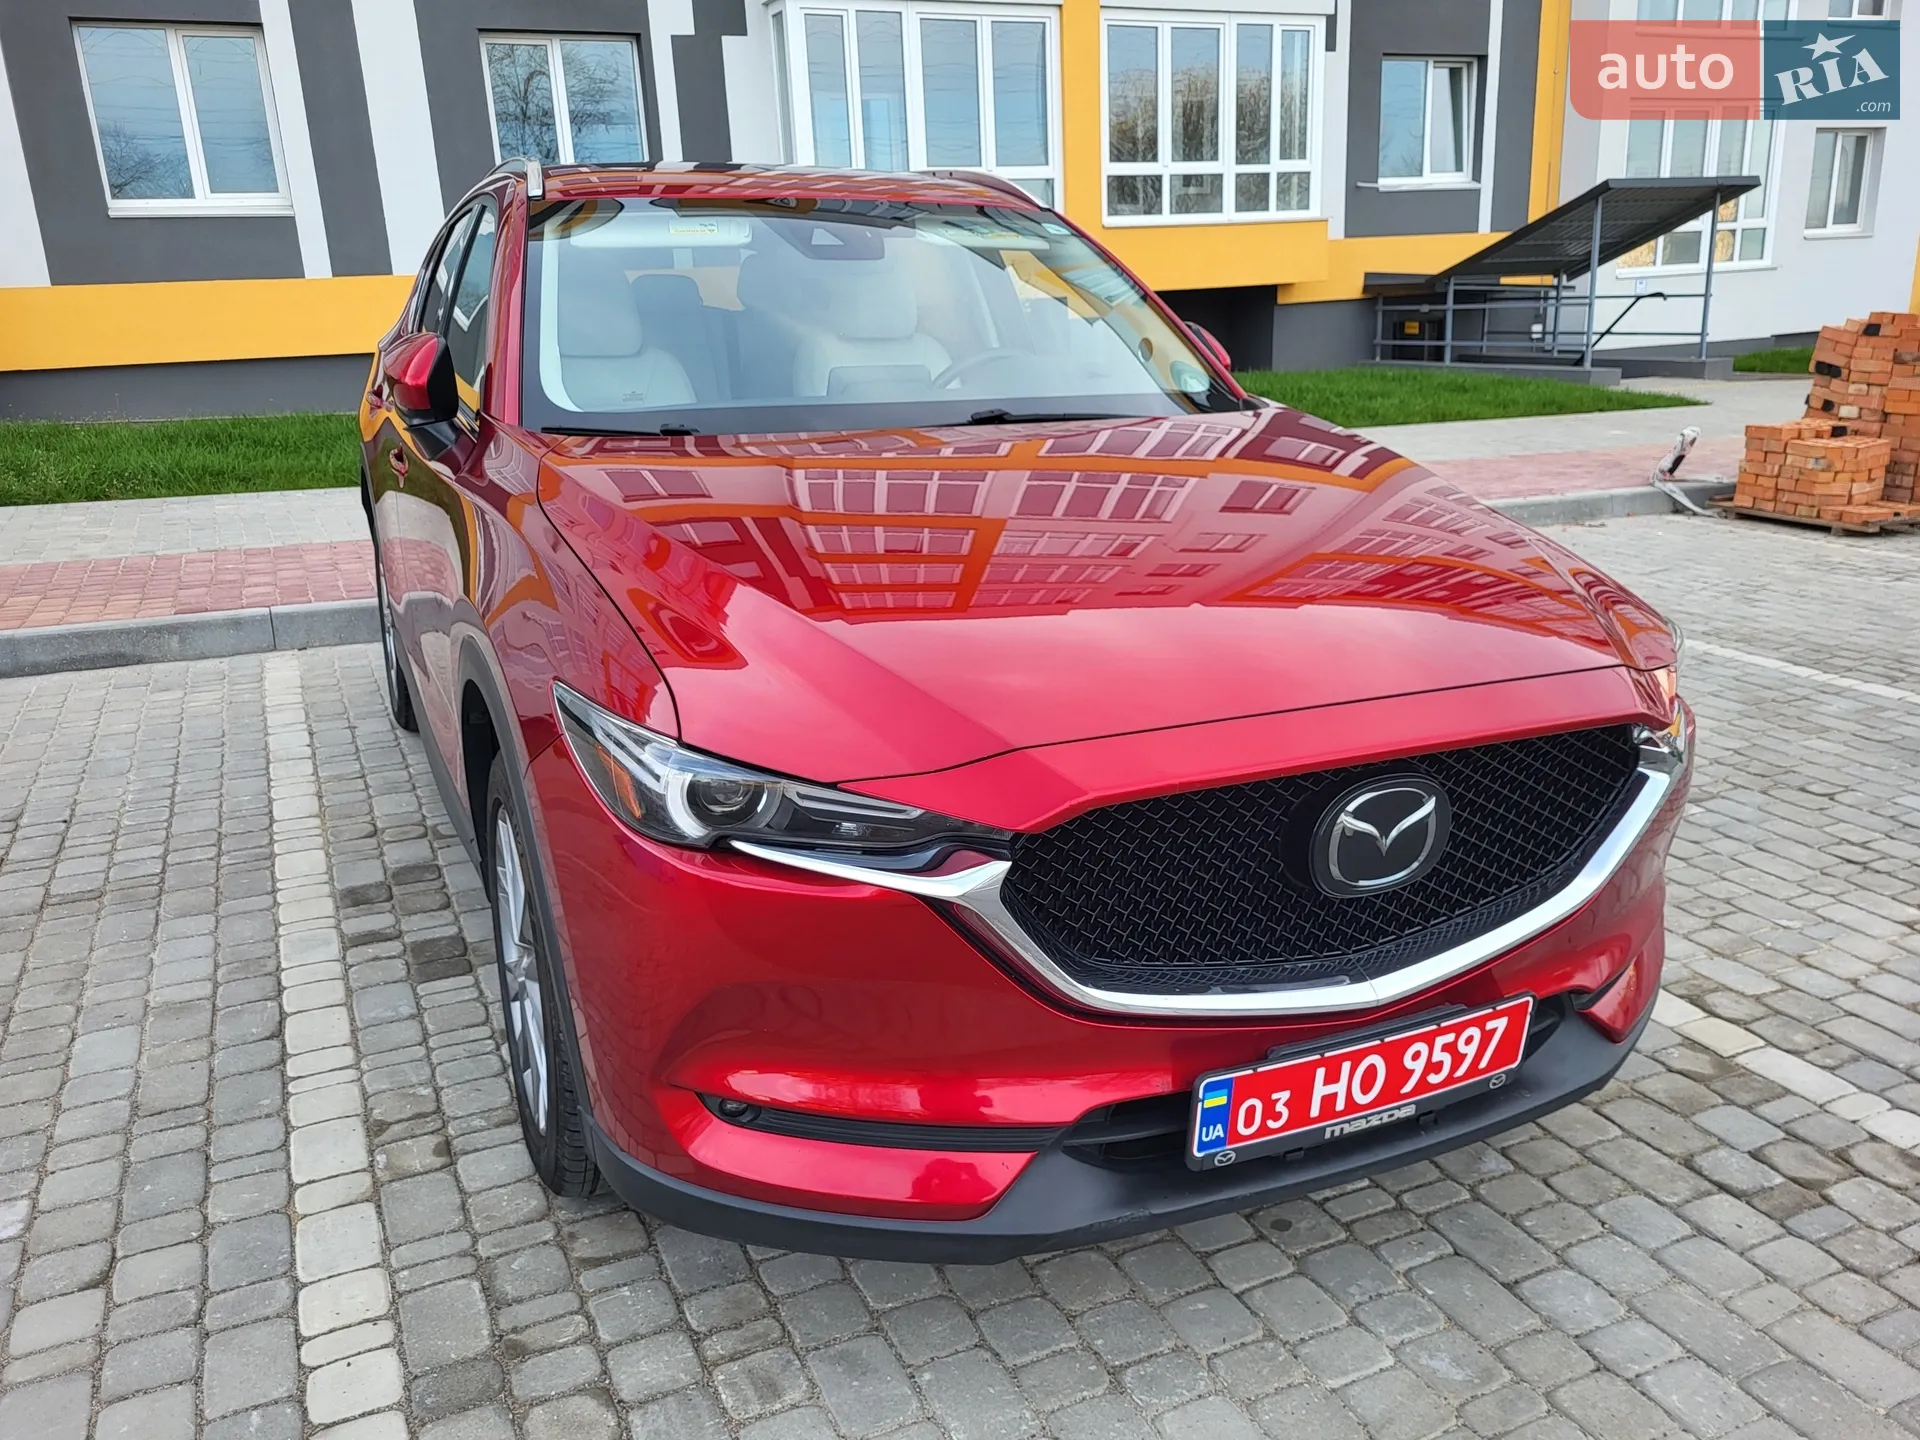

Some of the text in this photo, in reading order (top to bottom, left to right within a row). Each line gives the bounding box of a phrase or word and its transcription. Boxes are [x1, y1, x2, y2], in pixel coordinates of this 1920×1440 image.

[1236, 1016, 1509, 1136] 03 HO 9597
[1201, 1122, 1225, 1142] UA
